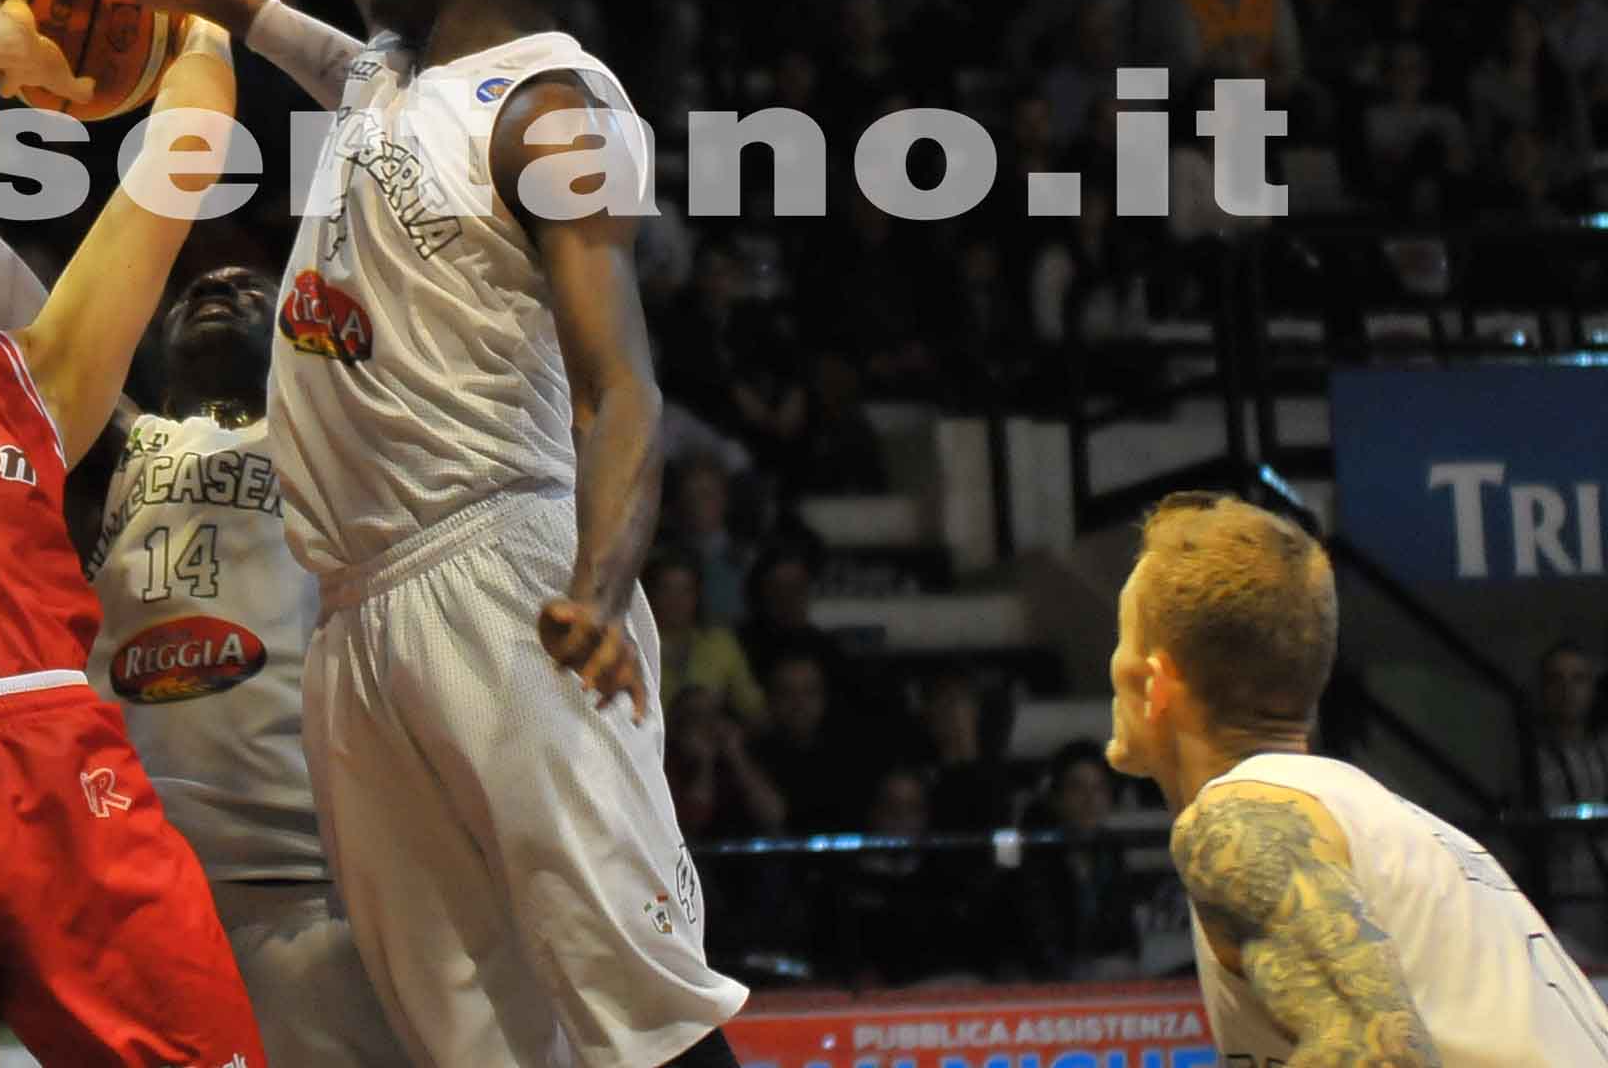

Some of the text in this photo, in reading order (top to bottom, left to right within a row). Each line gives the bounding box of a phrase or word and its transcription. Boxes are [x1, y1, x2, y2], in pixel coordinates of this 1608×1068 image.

[143, 523, 220, 604] 14
[124, 631, 246, 680] REGGIA
[853, 1010, 1203, 1051] PUBBLICA ASSISTENZA
